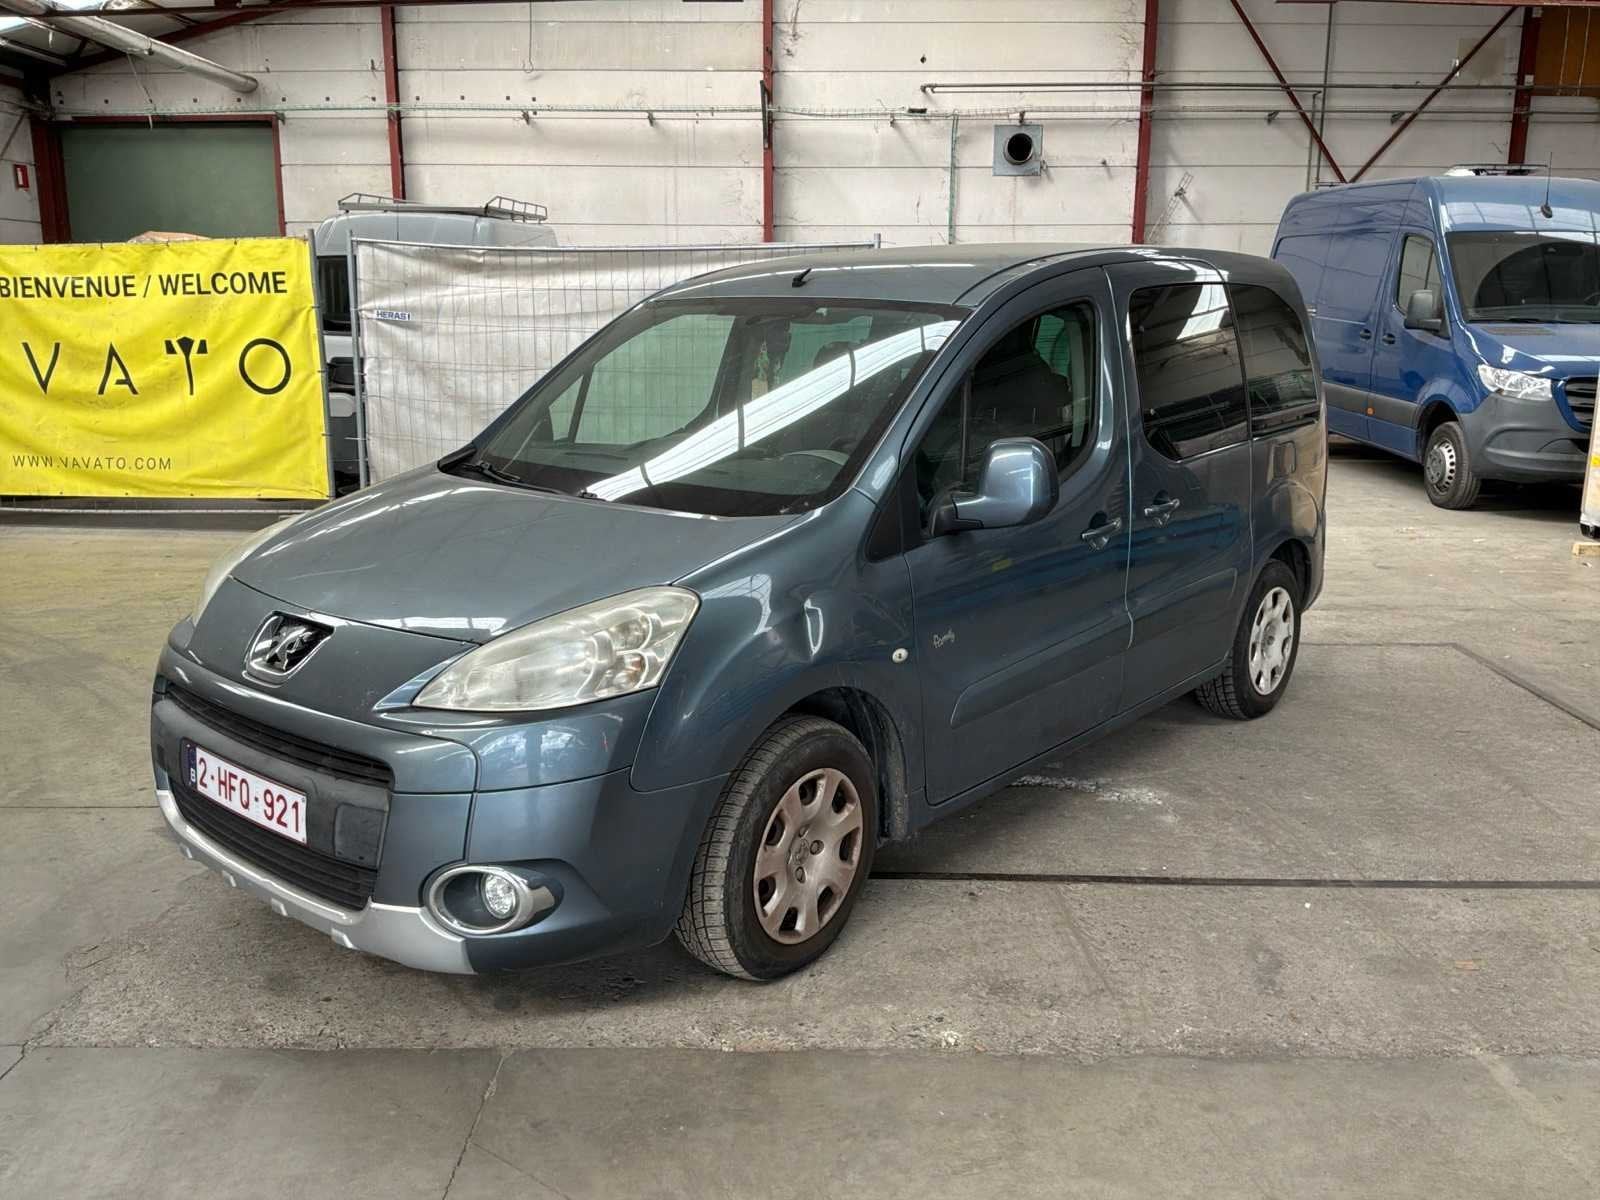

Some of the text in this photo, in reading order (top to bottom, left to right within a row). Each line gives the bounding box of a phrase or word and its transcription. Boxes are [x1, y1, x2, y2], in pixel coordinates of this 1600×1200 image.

[0, 275, 137, 298] BIENVENUE
[158, 271, 288, 295] WELCOME
[12, 455, 172, 471] WWW.VAVATO.COM
